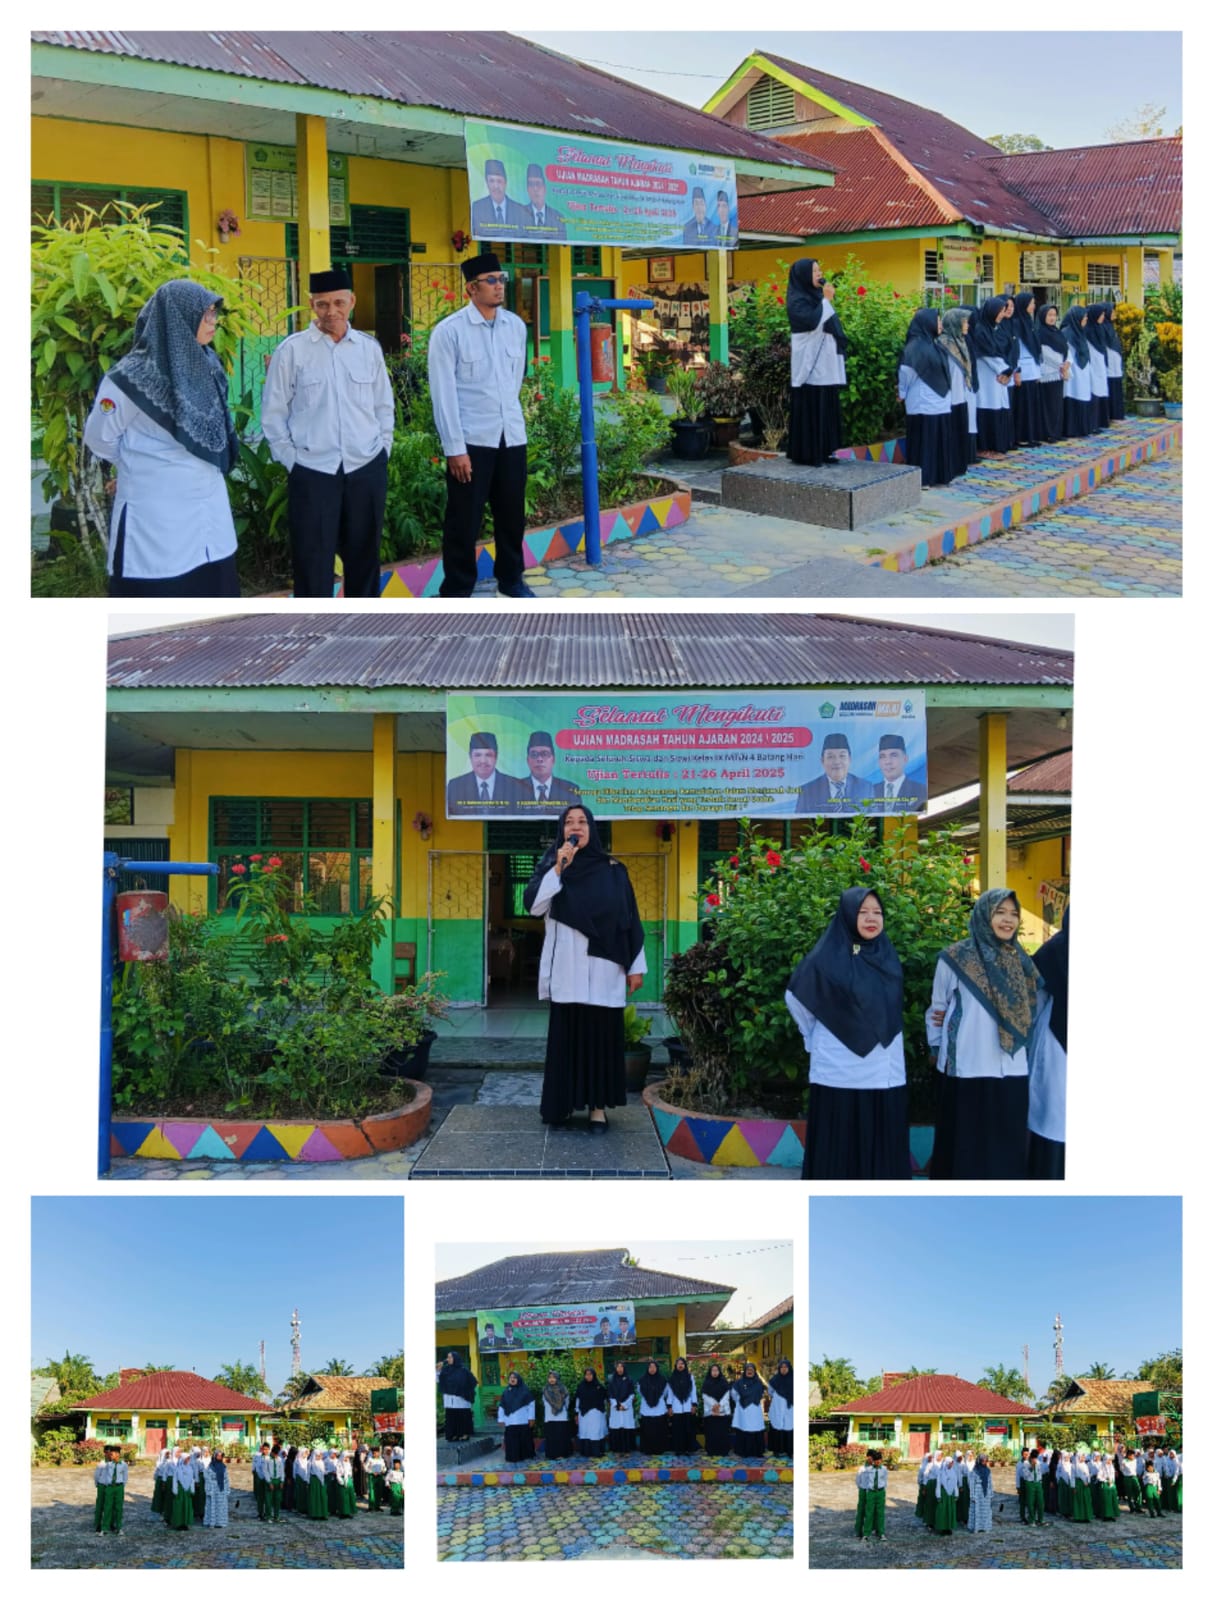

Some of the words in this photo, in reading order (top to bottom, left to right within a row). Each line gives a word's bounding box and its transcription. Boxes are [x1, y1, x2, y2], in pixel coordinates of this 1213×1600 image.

[573, 704, 668, 727] Selamat
[673, 703, 786, 727] Mengikuti
[573, 734, 602, 745] UJIAN
[605, 734, 659, 745] MADRASAH
[662, 734, 695, 744] TAHUN
[698, 733, 738, 744] AJARAN
[740, 733, 763, 744] 2024
[771, 732, 795, 743] 2025
[565, 754, 594, 764] Kepada
[757, 752, 785, 762] Batang
[587, 768, 619, 781] Ujian
[622, 768, 670, 780] Tertulis
[681, 768, 717, 780] 21-26
[720, 767, 751, 781] April
[753, 766, 785, 778] 2025
